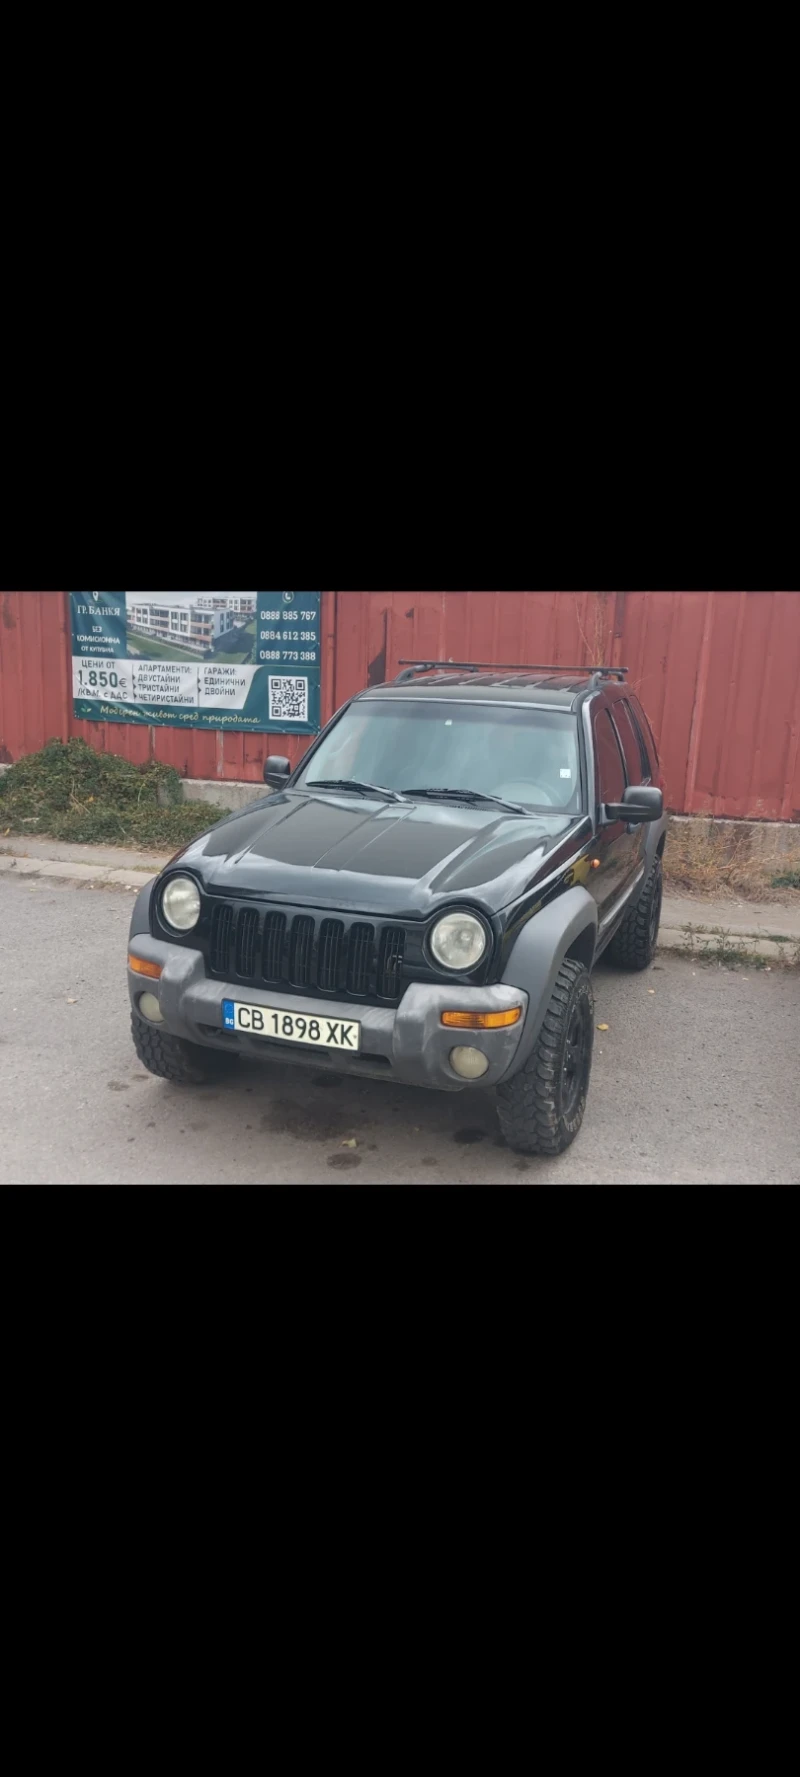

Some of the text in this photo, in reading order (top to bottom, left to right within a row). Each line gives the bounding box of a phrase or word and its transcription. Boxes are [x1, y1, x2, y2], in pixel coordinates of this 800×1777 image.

[260, 610, 316, 620] 0888 885 767
[260, 631, 316, 641] 0884 612 385
[260, 650, 316, 661] 0888 773 388
[81, 660, 115, 669] ЦЕНИ ОТ
[138, 664, 192, 674] АПАРТАМЕНТИ:
[137, 673, 181, 683] ДВУСТАЙНИ
[204, 677, 246, 686] ЕДИНИЧНИ
[137, 683, 180, 693] ТРИСТАЙНИ
[204, 687, 236, 696] ДВОЙНИ
[138, 693, 195, 703] ЧЕТИРИСТАЙНИ
[178, 712, 199, 722] сред
[202, 714, 260, 725] природата
[271, 1013, 321, 1041] 1898
